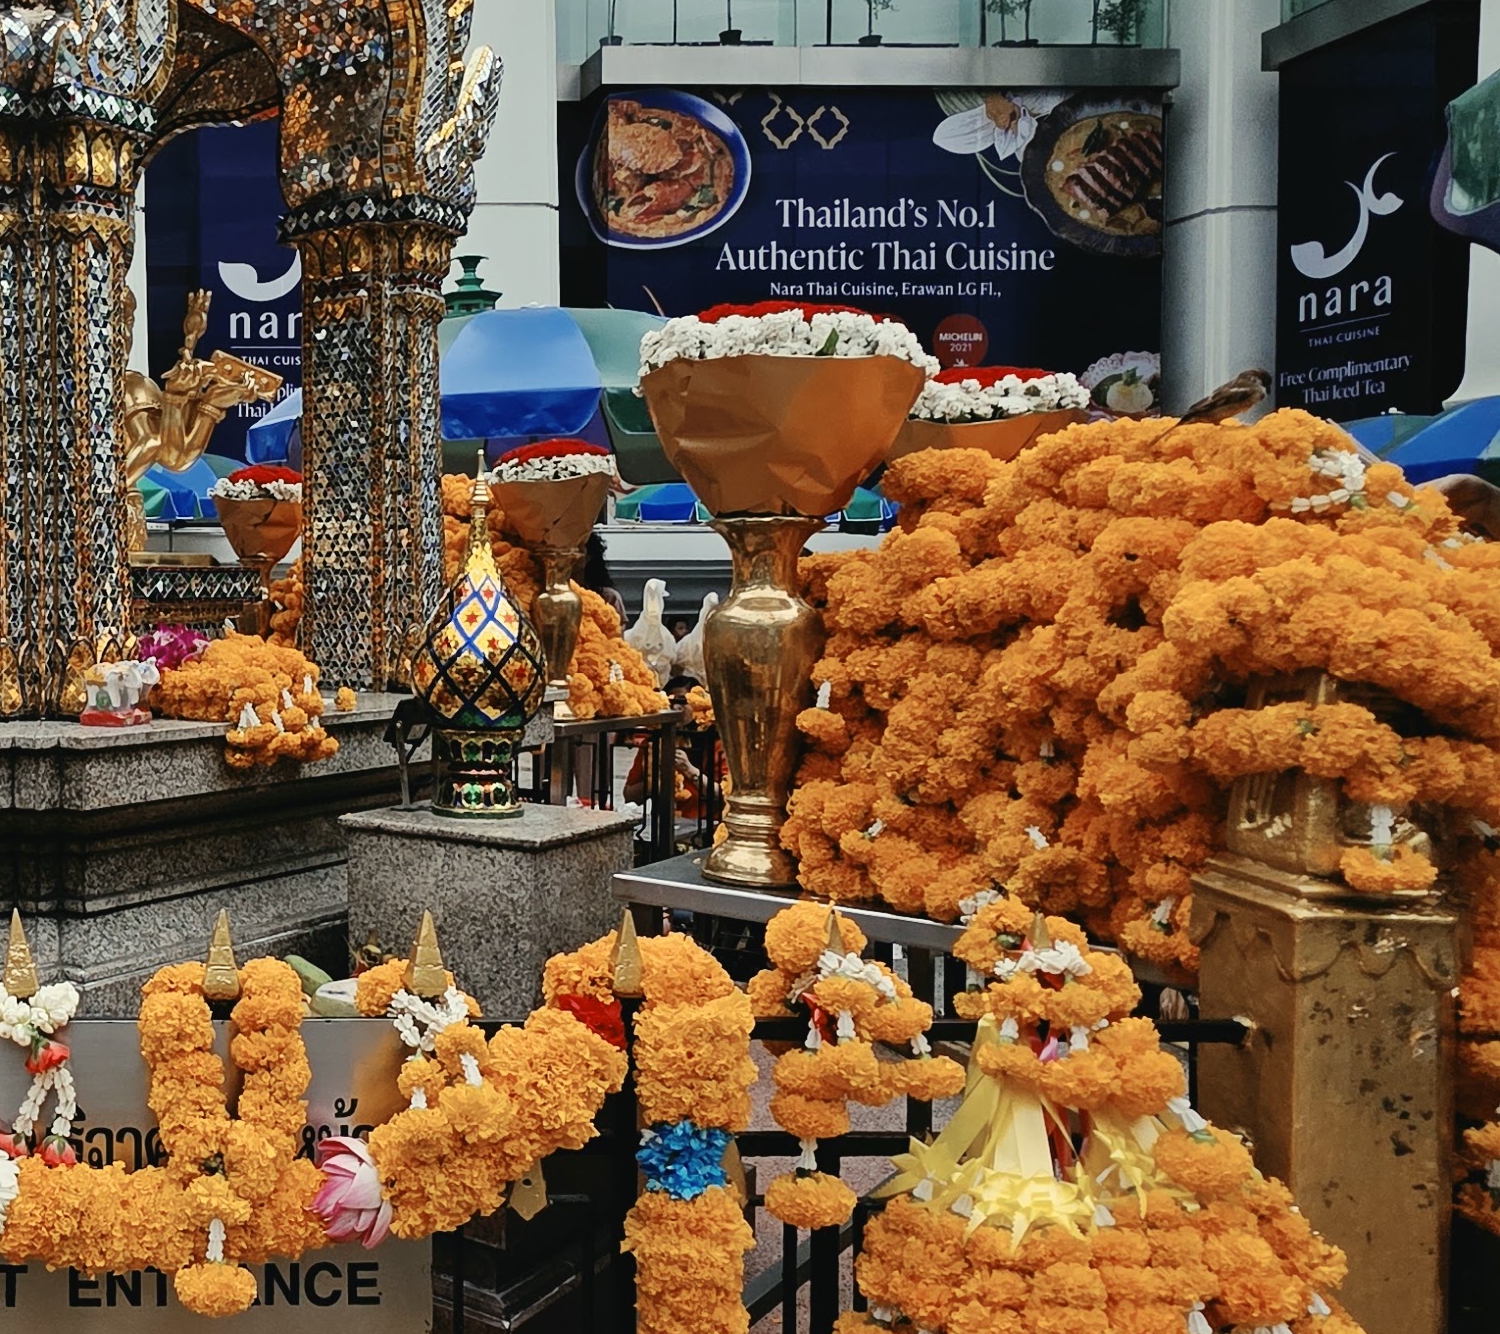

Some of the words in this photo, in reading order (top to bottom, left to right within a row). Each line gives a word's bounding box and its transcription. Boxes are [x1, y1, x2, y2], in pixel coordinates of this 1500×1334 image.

[776, 198, 928, 229] Thailand’s
[937, 199, 996, 229] No.1
[715, 241, 865, 271] Authentic
[872, 242, 937, 271] Thai
[946, 242, 1056, 271] Cuisine
[770, 282, 804, 296] Nara
[806, 282, 838, 296] Thai
[841, 283, 899, 298] Cuisine,
[902, 283, 954, 296] Erawan
[958, 283, 977, 296] LG
[1299, 275, 1392, 322] nara
[229, 312, 303, 339] nar
[939, 332, 983, 342] MICHELIN
[1308, 335, 1333, 347] THAI
[1336, 326, 1380, 343] CUISINE
[273, 355, 302, 366] CUIS
[950, 344, 973, 353] 2021
[1280, 371, 1306, 387] Free
[1308, 355, 1413, 382] Complimentary
[1302, 385, 1330, 404] Thai
[1332, 380, 1360, 400] Iced
[1362, 378, 1386, 395] Tea
[68, 1260, 381, 1308] ENTNCE
